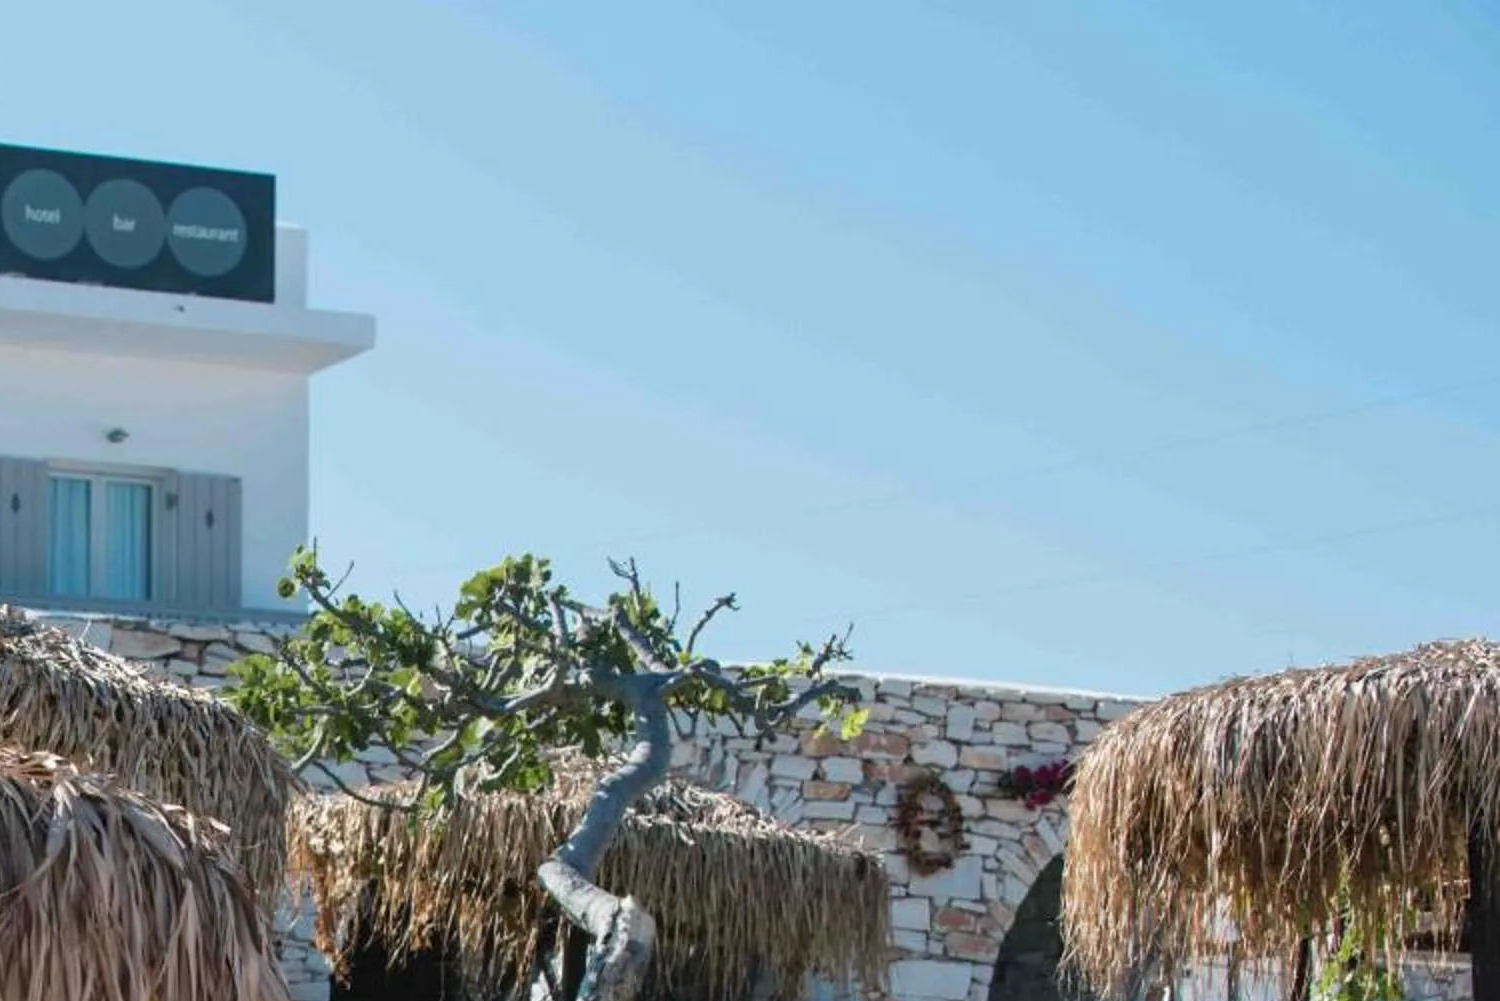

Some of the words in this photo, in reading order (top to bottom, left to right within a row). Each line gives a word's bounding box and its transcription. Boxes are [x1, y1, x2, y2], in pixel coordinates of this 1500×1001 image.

[25, 204, 61, 225] hotel
[113, 214, 136, 232] bar
[173, 223, 239, 243] restaurant
